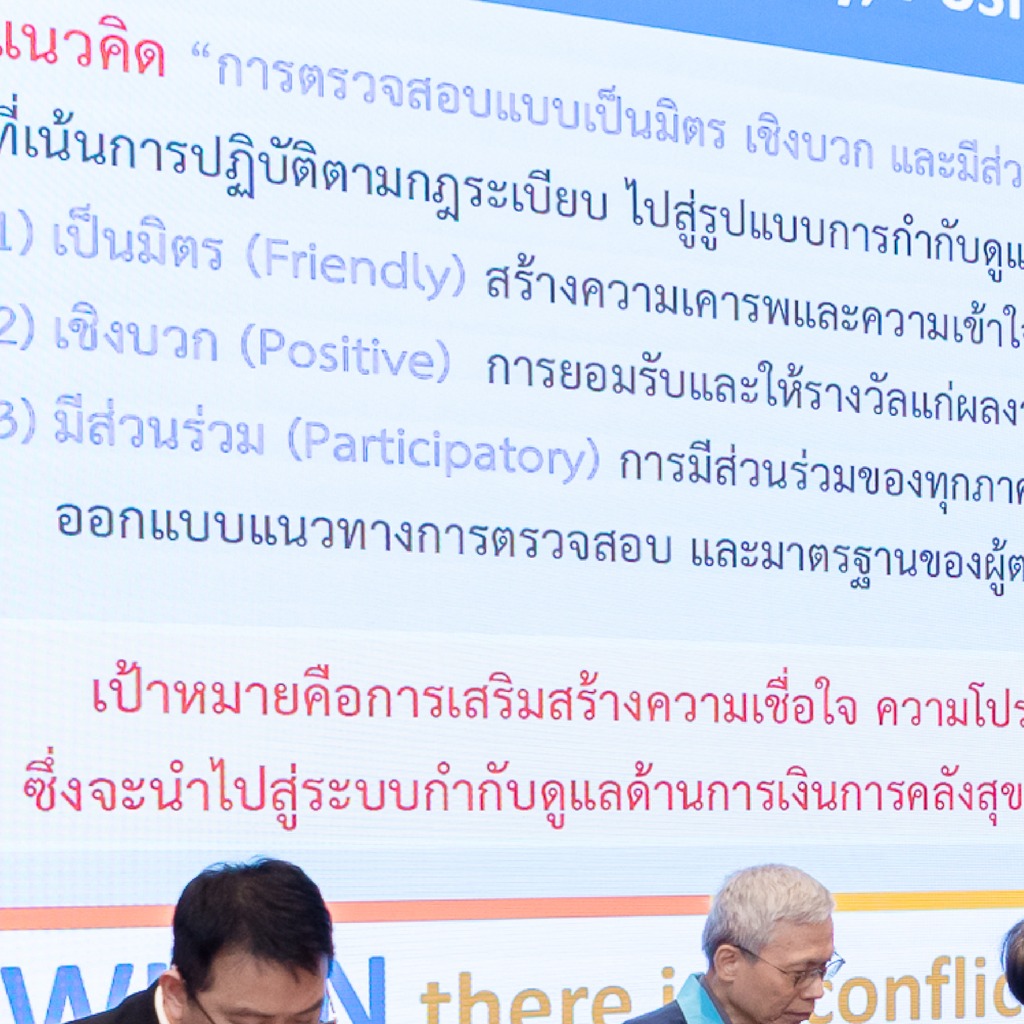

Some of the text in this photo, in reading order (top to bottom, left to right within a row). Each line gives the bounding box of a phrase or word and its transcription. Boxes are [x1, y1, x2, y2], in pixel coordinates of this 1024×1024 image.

[746, 112, 873, 169] เชิงบวก
[53, 206, 223, 271] เป็นมิตร
[246, 232, 466, 302] (Friendly)
[0, 303, 35, 351] 2)
[55, 302, 218, 361] เชิงบวก
[241, 323, 450, 384] (Positive)
[0, 396, 37, 445] 3)
[52, 393, 264, 456] มีส่วนร่วม
[288, 416, 600, 485] (Participatory)
[55, 502, 672, 565] ออกแบบแนวทางการตรวจสอบ
[92, 659, 857, 725] เป้าหมายคือการเสริมสร้างความเชื่อใจ
